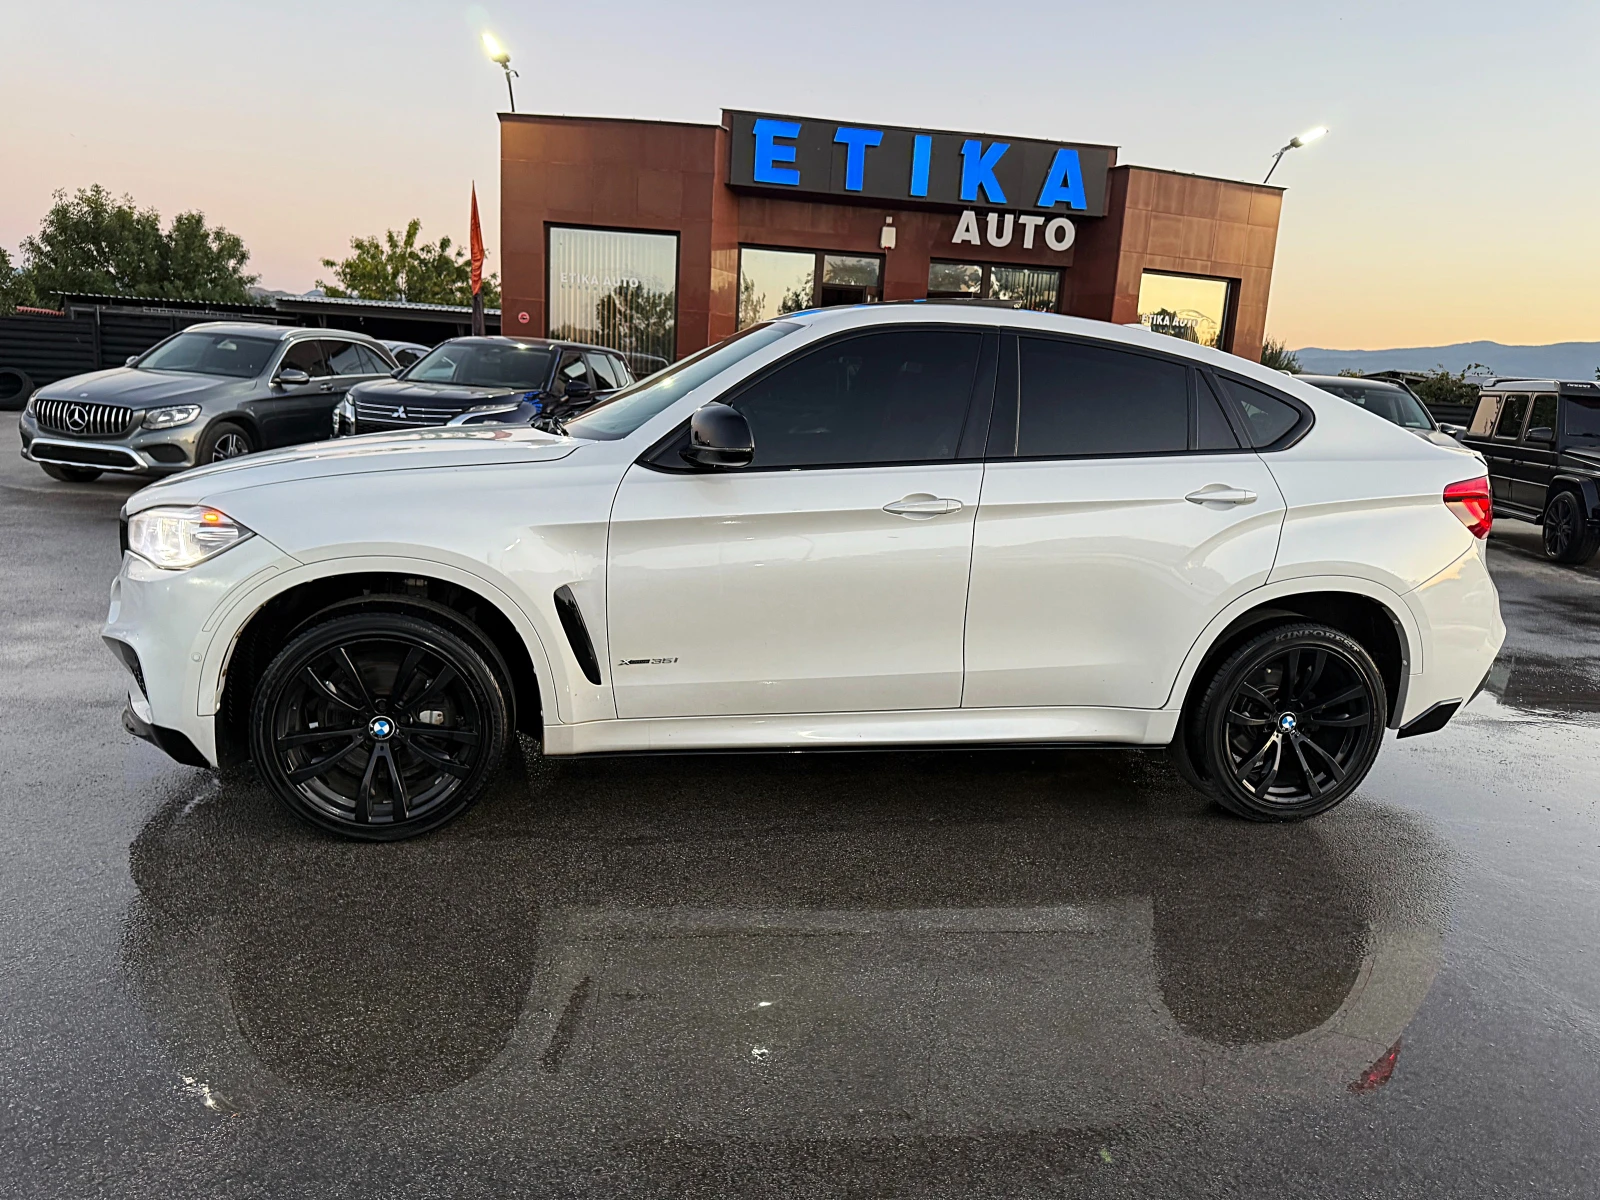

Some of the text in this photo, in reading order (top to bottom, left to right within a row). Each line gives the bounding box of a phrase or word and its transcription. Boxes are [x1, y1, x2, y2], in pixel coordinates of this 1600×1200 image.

[752, 118, 1087, 210] ETIKA
[951, 210, 1076, 251] AUTO
[560, 272, 599, 286] ETIKA
[603, 275, 639, 288] AUTO
[1141, 313, 1199, 328] ETIKA AUTO
